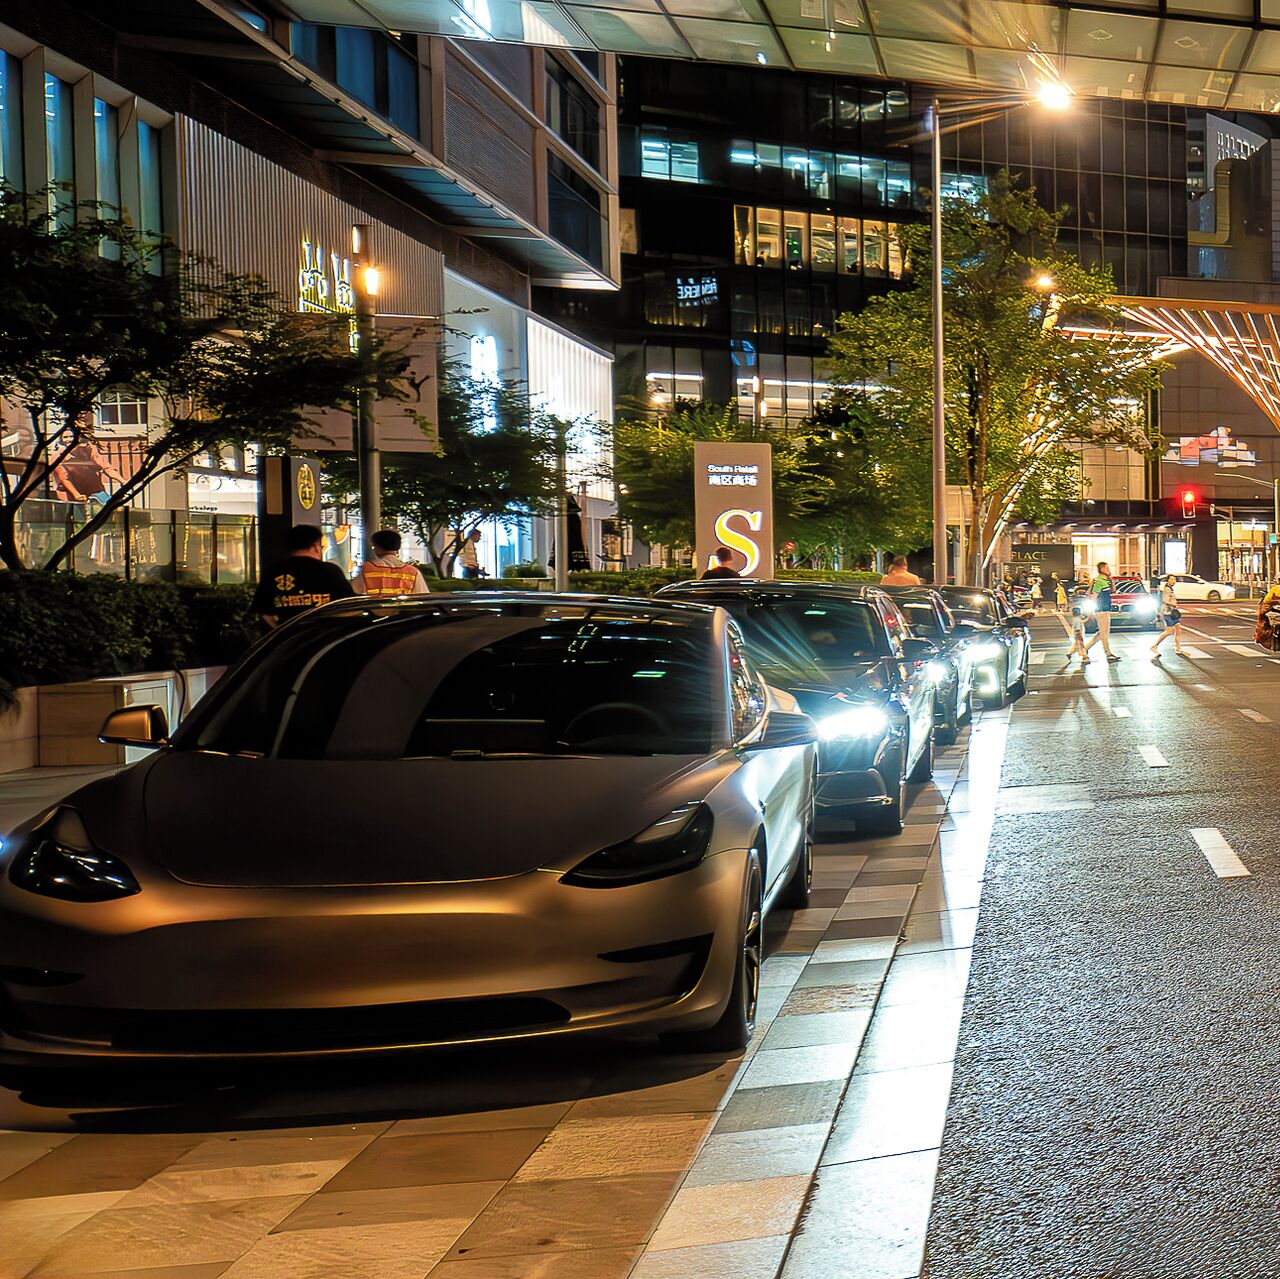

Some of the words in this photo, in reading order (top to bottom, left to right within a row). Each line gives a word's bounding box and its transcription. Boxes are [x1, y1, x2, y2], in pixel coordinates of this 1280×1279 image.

[707, 464, 733, 472] South
[734, 465, 758, 473] Retail
[708, 508, 762, 577] S
[1011, 551, 1048, 561] PLACE
